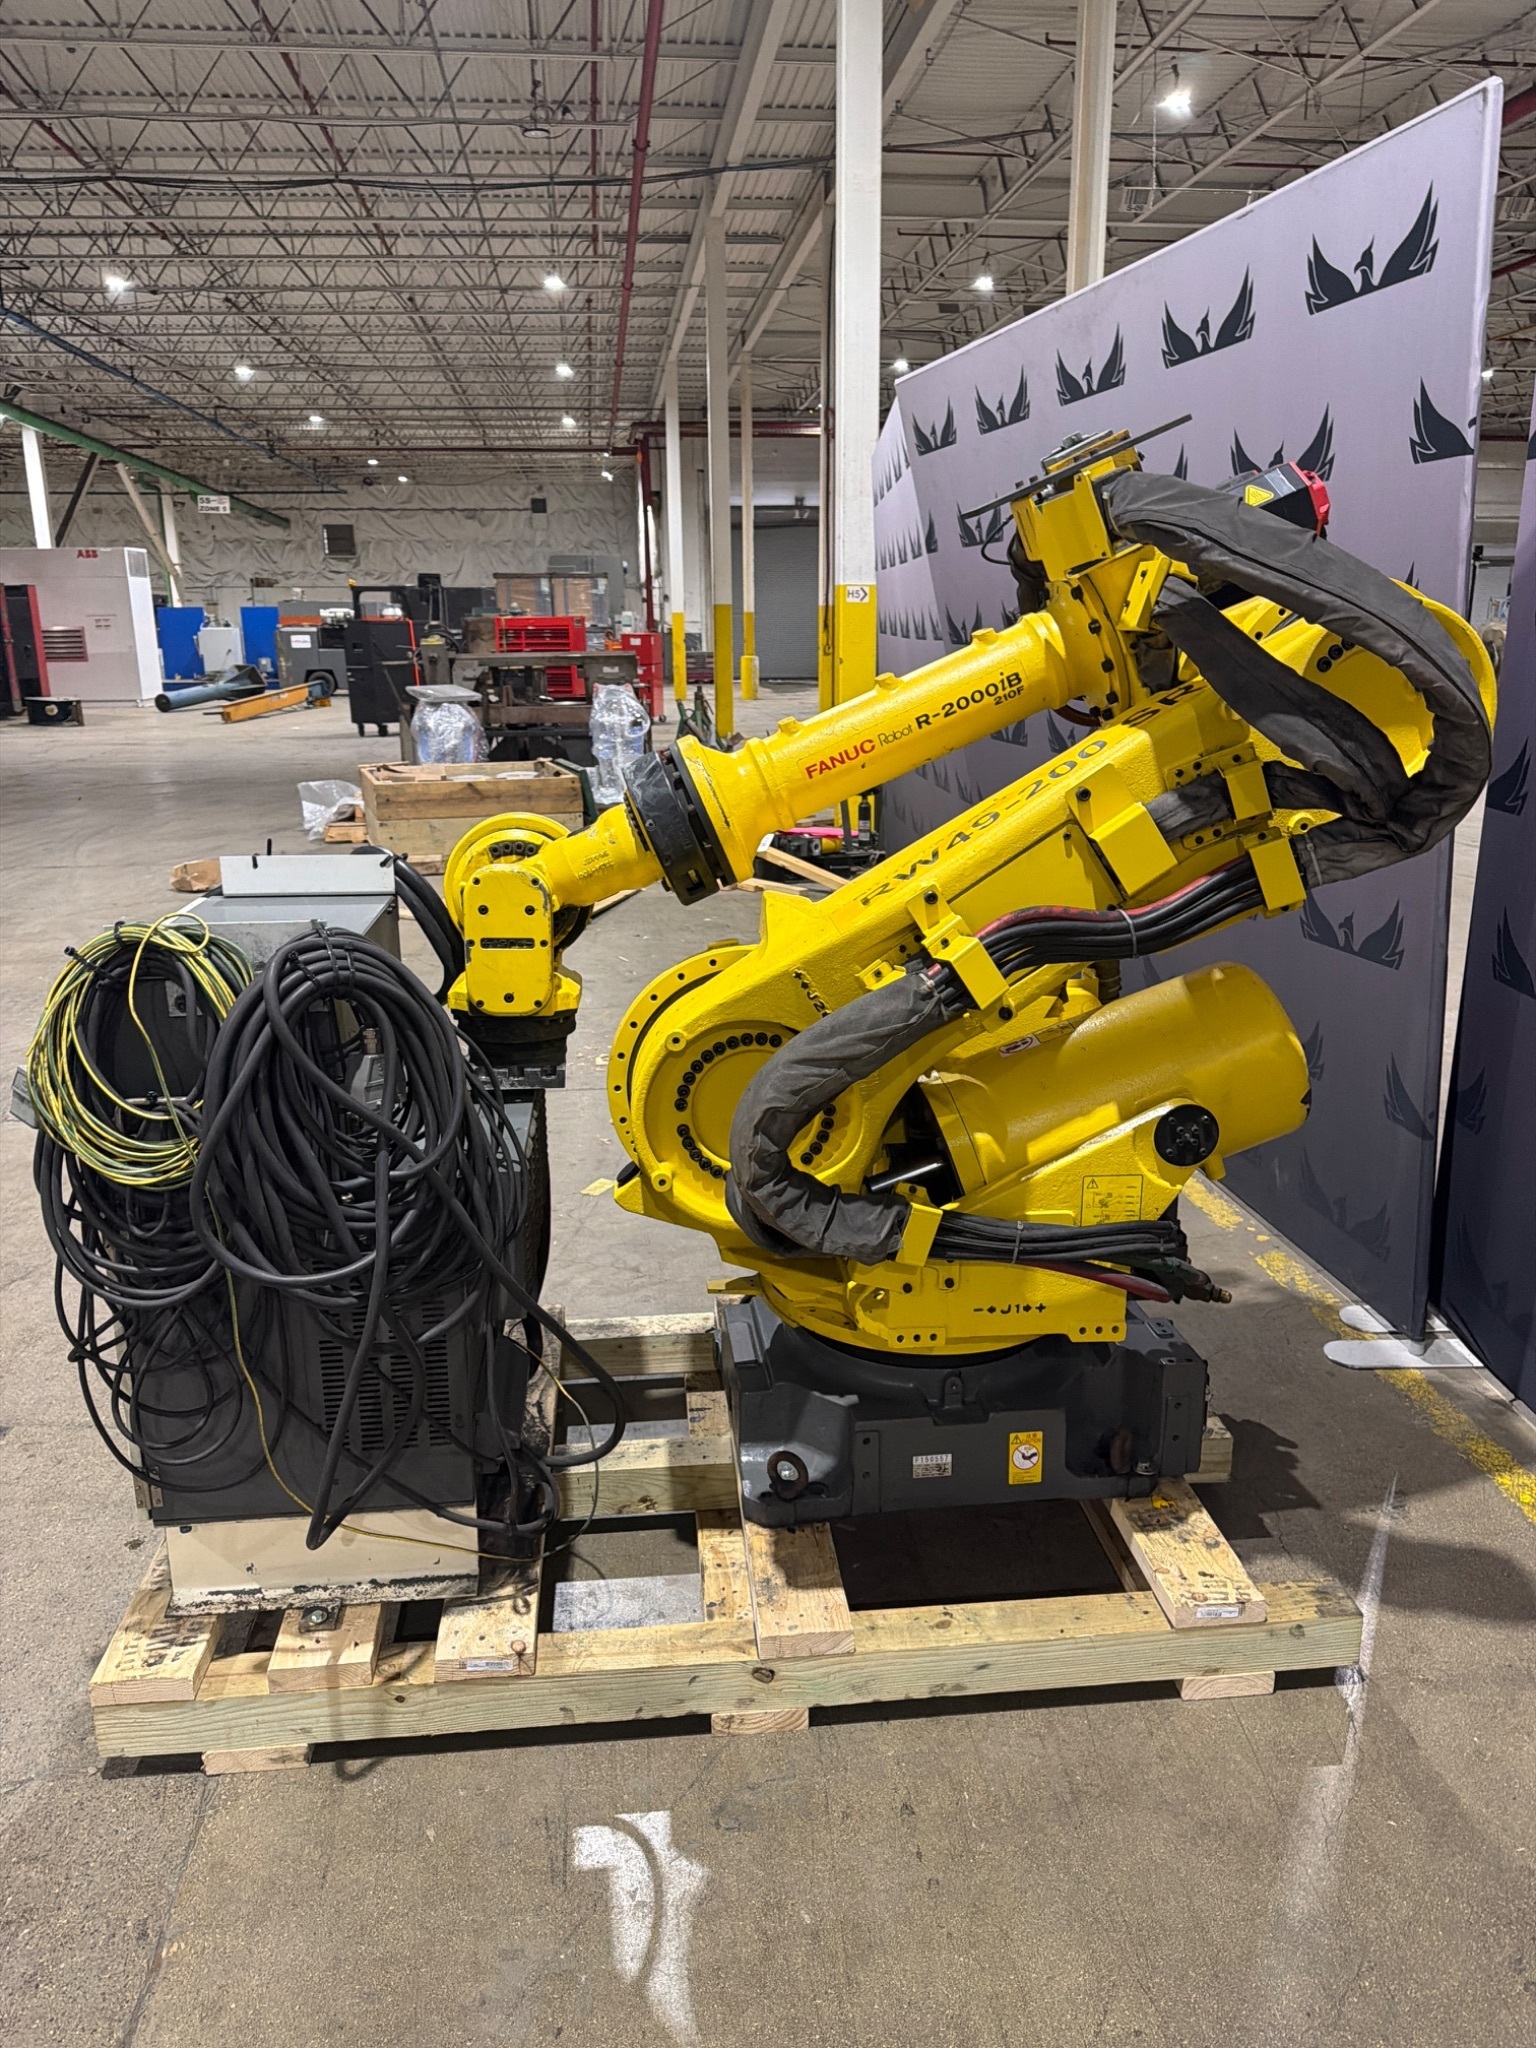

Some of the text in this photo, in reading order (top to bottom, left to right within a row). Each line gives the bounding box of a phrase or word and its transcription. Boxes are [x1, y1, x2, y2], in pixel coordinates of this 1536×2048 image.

[792, 509, 811, 519] 17
[76, 549, 99, 559] ABB
[846, 589, 861, 599] H5
[993, 685, 1025, 706] 210F
[805, 671, 1023, 780] FANUC Robot R-2000iB
